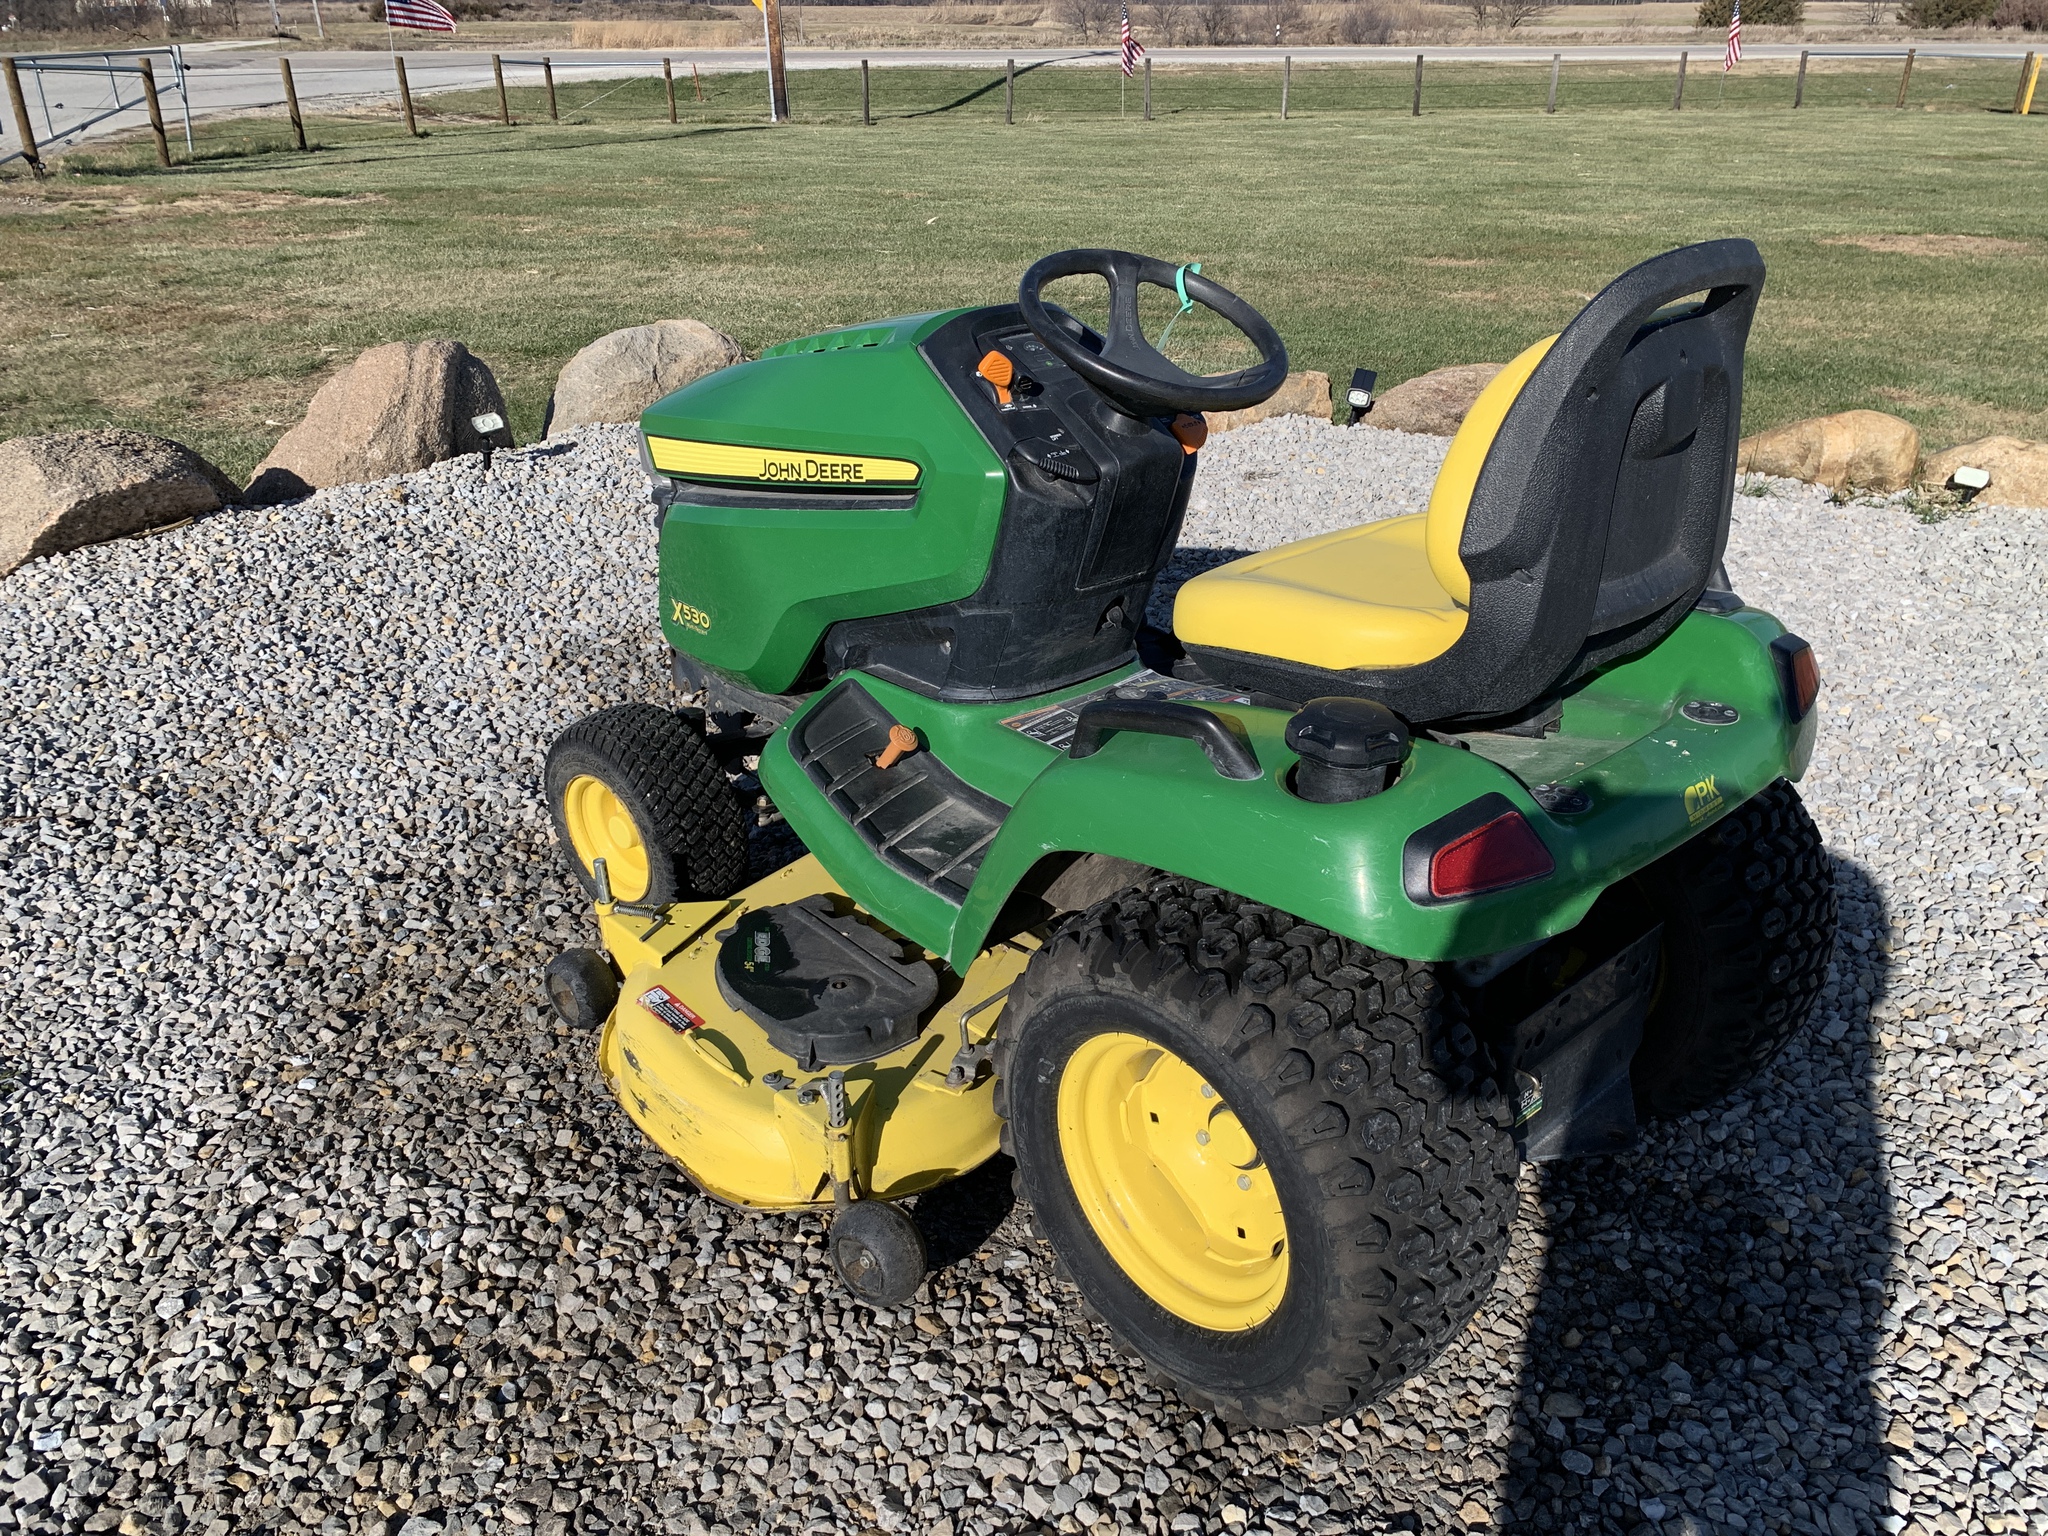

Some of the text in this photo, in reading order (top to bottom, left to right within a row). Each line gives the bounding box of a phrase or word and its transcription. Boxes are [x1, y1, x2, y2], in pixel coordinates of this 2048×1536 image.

[759, 459, 864, 479] JOHN DEERE
[671, 598, 710, 629] X530
[754, 930, 771, 964] EDGE
[678, 1004, 696, 1019] DANGER
